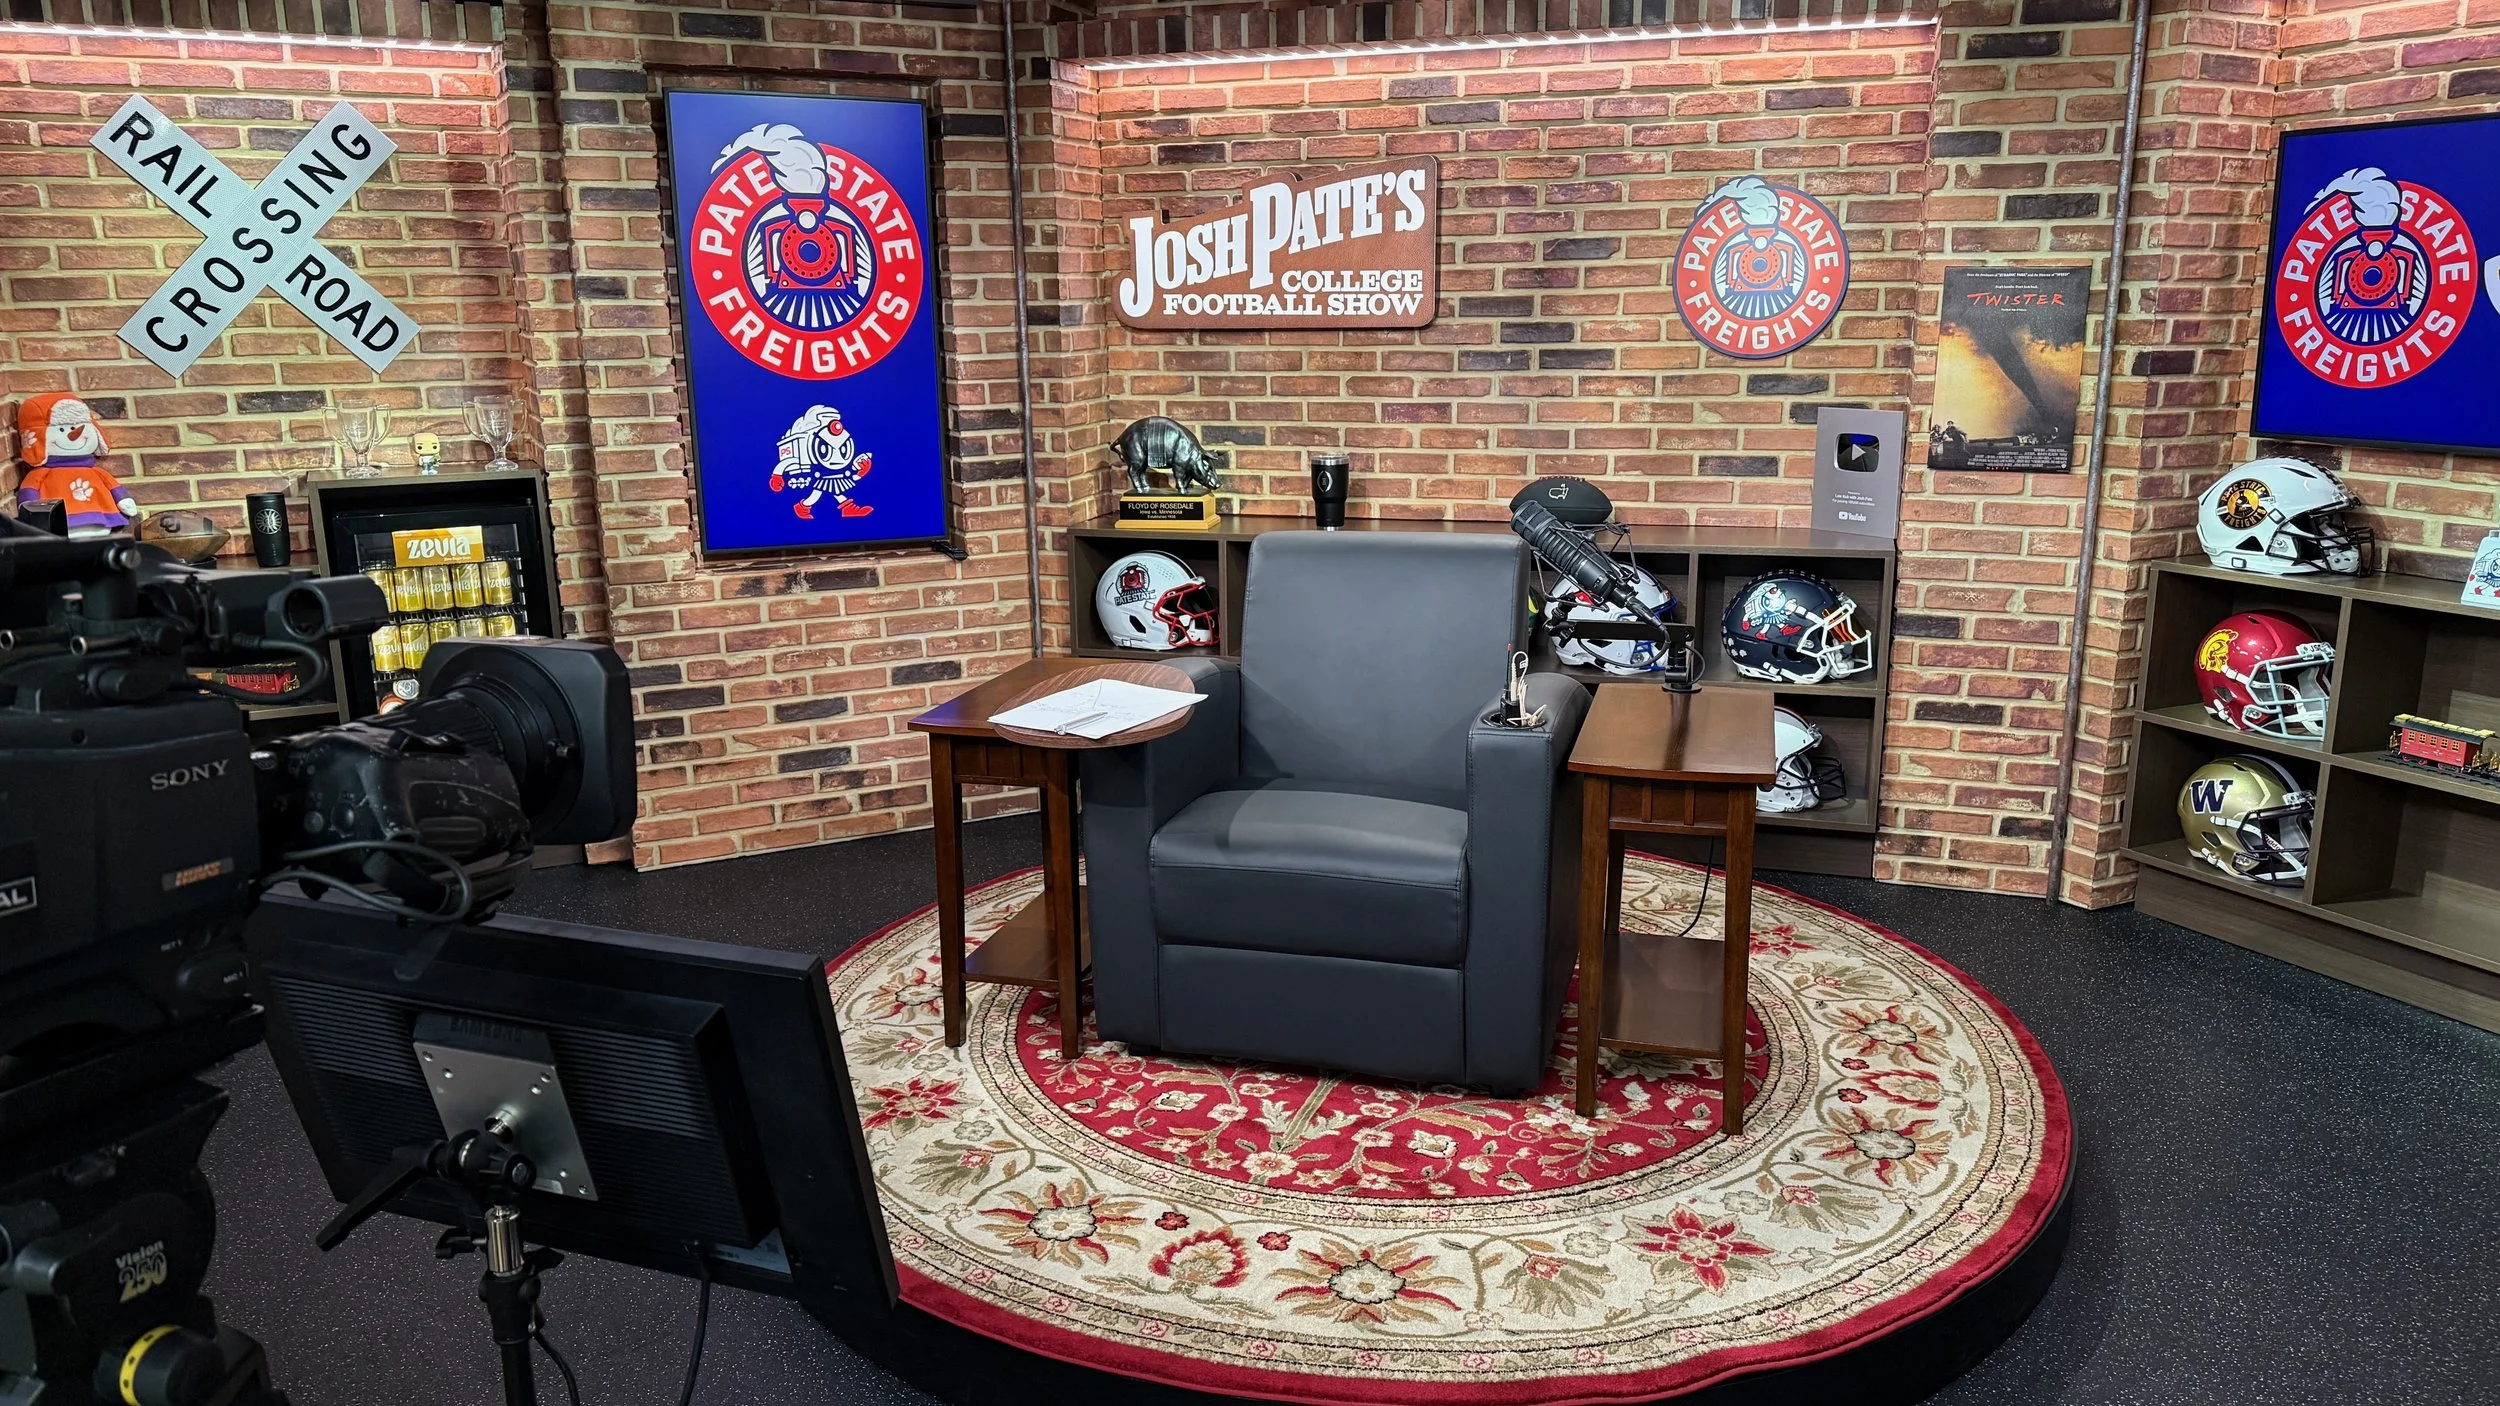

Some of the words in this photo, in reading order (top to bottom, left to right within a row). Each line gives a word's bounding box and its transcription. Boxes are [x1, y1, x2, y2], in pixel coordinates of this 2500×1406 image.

[109, 111, 219, 218] RAIL
[285, 254, 400, 353] ROAD
[699, 158, 777, 257] PATE
[828, 155, 915, 263] STATE
[1683, 203, 1740, 271] PATE
[1779, 196, 1839, 270] STATE
[145, 123, 372, 353] CROSSING
[1119, 213, 1248, 318] JOSH
[1249, 169, 1426, 290] PATE'S
[2284, 198, 2354, 283] PATE
[2400, 190, 2470, 285] STATE
[1163, 294, 1322, 316] FOOTBALL
[1327, 293, 1424, 316] SHOW
[1281, 270, 1423, 292] COLLEGE
[1967, 292, 2065, 306] TWISTER
[708, 287, 910, 373] FREIGHTS
[1685, 289, 1831, 350] FREIGHTS
[2283, 307, 2456, 382] FREIGHTS
[1127, 502, 1149, 510] FLOYD
[1149, 502, 1159, 510] OF
[1159, 502, 1194, 510] ROSEDALE
[1847, 512, 1867, 522] YouTube
[406, 536, 471, 560] zevia
[150, 759, 230, 791] SONY
[2191, 779, 2234, 814] W
[115, 1239, 165, 1269] Vision
[118, 1251, 168, 1304] 250
